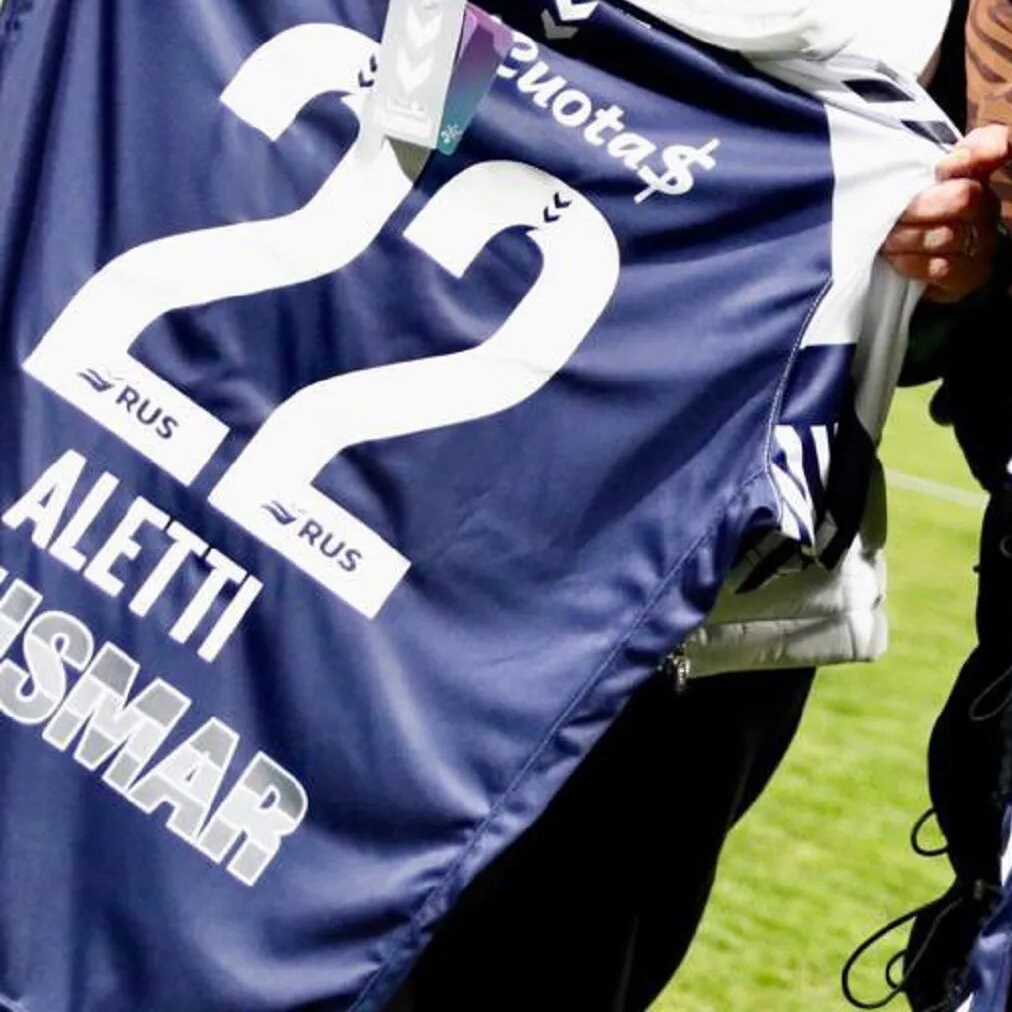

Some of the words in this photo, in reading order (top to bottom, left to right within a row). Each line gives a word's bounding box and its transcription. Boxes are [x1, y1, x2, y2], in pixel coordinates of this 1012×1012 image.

[22, 22, 620, 620] 22
[116, 384, 179, 440] RUS
[1, 448, 264, 663] ALETTI
[298, 518, 362, 573] RUS
